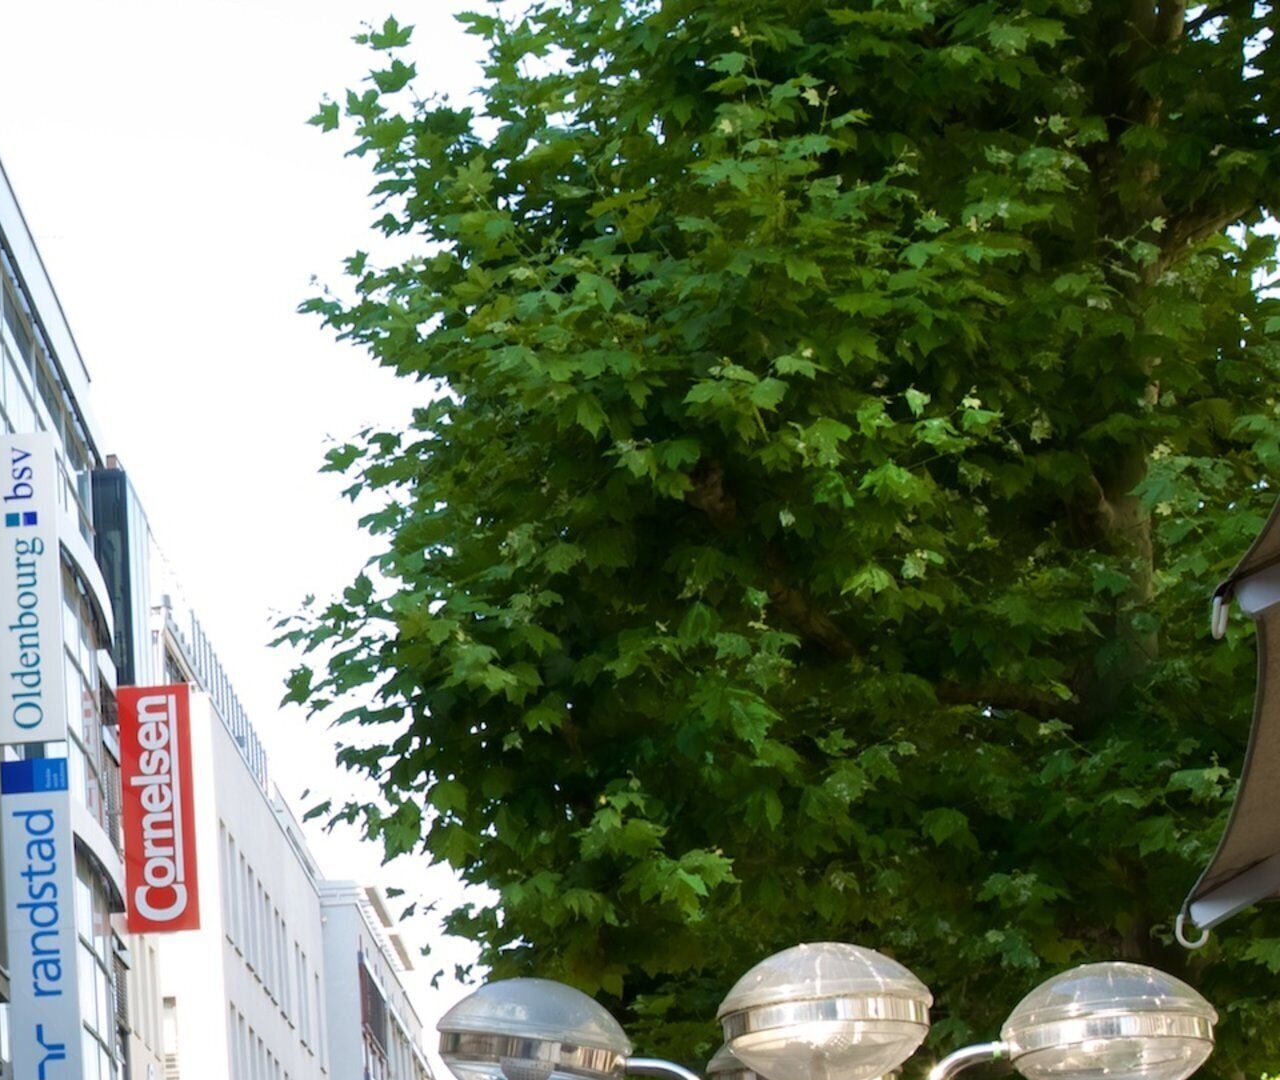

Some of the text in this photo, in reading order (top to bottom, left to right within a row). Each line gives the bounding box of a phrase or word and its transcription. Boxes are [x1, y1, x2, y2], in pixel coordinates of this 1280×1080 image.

[3, 446, 45, 730] Oldenbourg bsv
[12, 808, 63, 998] randstad
[130, 694, 188, 922] Cornelsen
